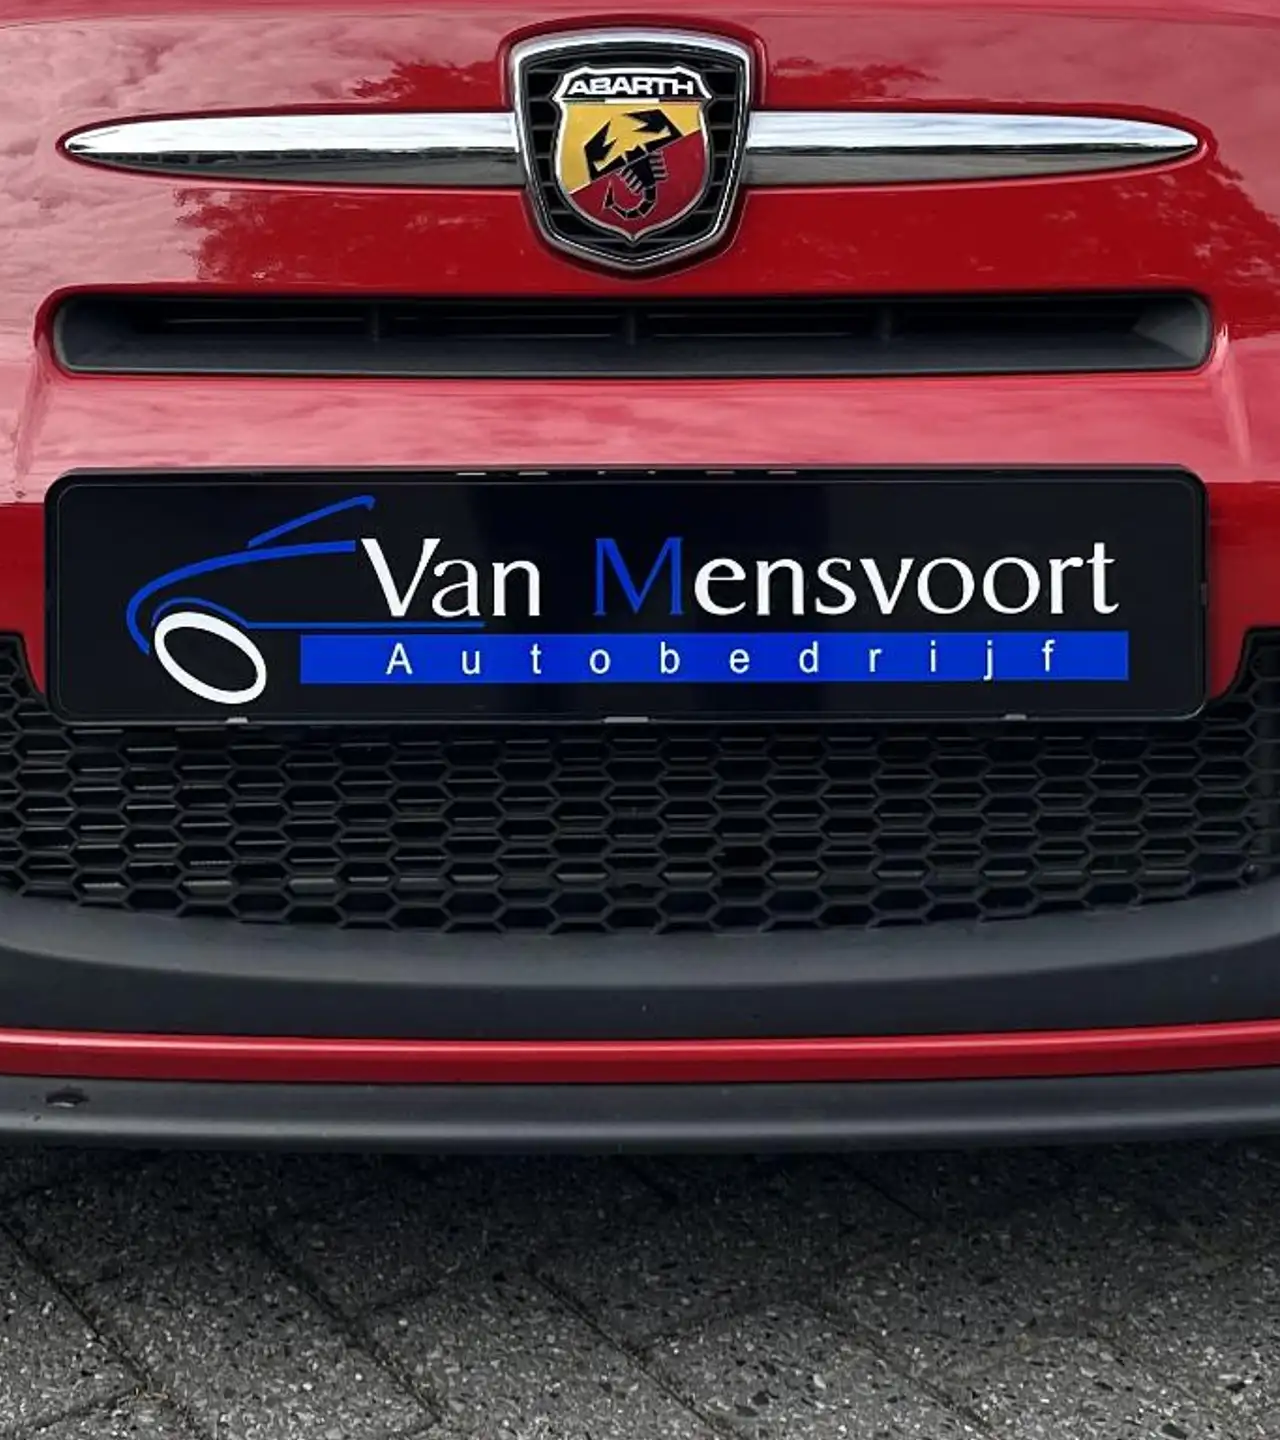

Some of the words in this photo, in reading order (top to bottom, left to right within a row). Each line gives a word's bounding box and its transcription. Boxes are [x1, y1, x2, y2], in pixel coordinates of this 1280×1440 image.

[568, 76, 694, 97] ABARTH
[360, 537, 542, 618] Van
[592, 536, 1121, 618] Mensvoort
[386, 641, 1056, 682] Autobedrijf
